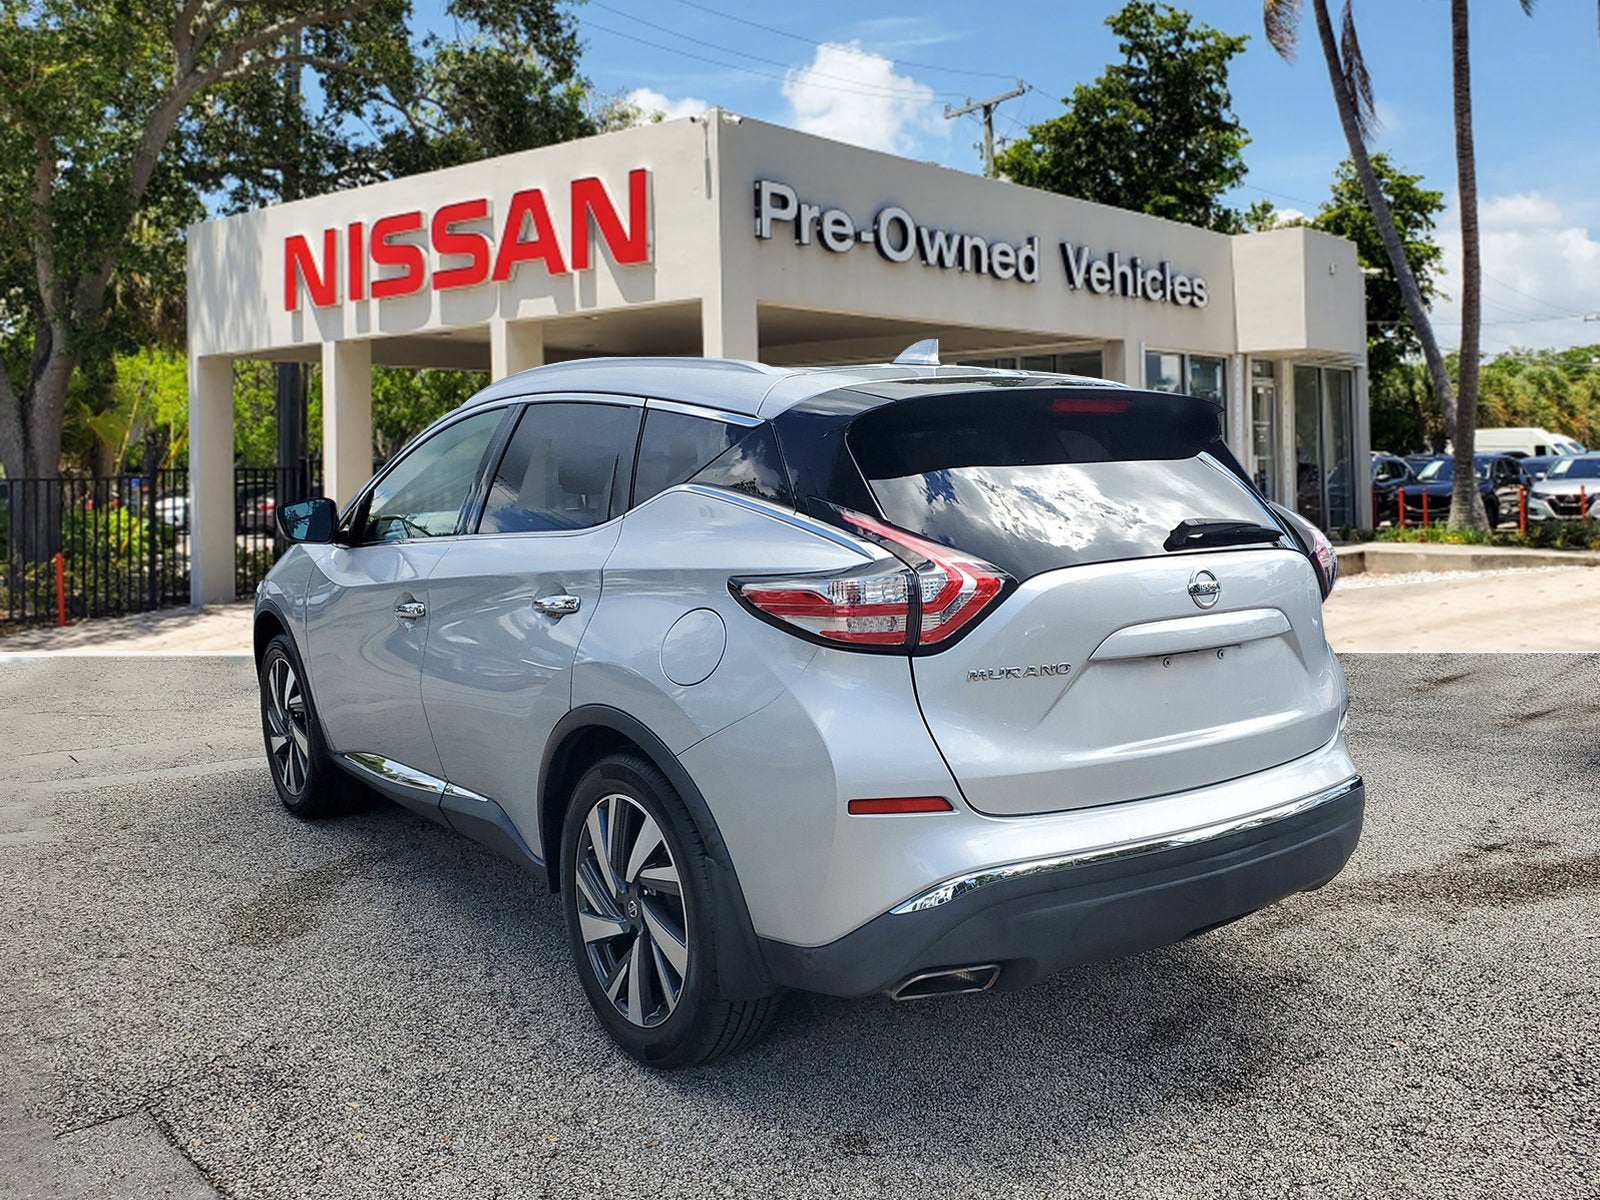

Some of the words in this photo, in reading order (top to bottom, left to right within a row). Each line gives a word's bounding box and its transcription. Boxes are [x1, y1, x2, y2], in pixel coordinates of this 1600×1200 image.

[284, 168, 650, 312] NISSAN
[754, 179, 1041, 285] Pre-Owned
[1061, 241, 1209, 308] Vehicles
[966, 661, 1072, 682] MURANO
